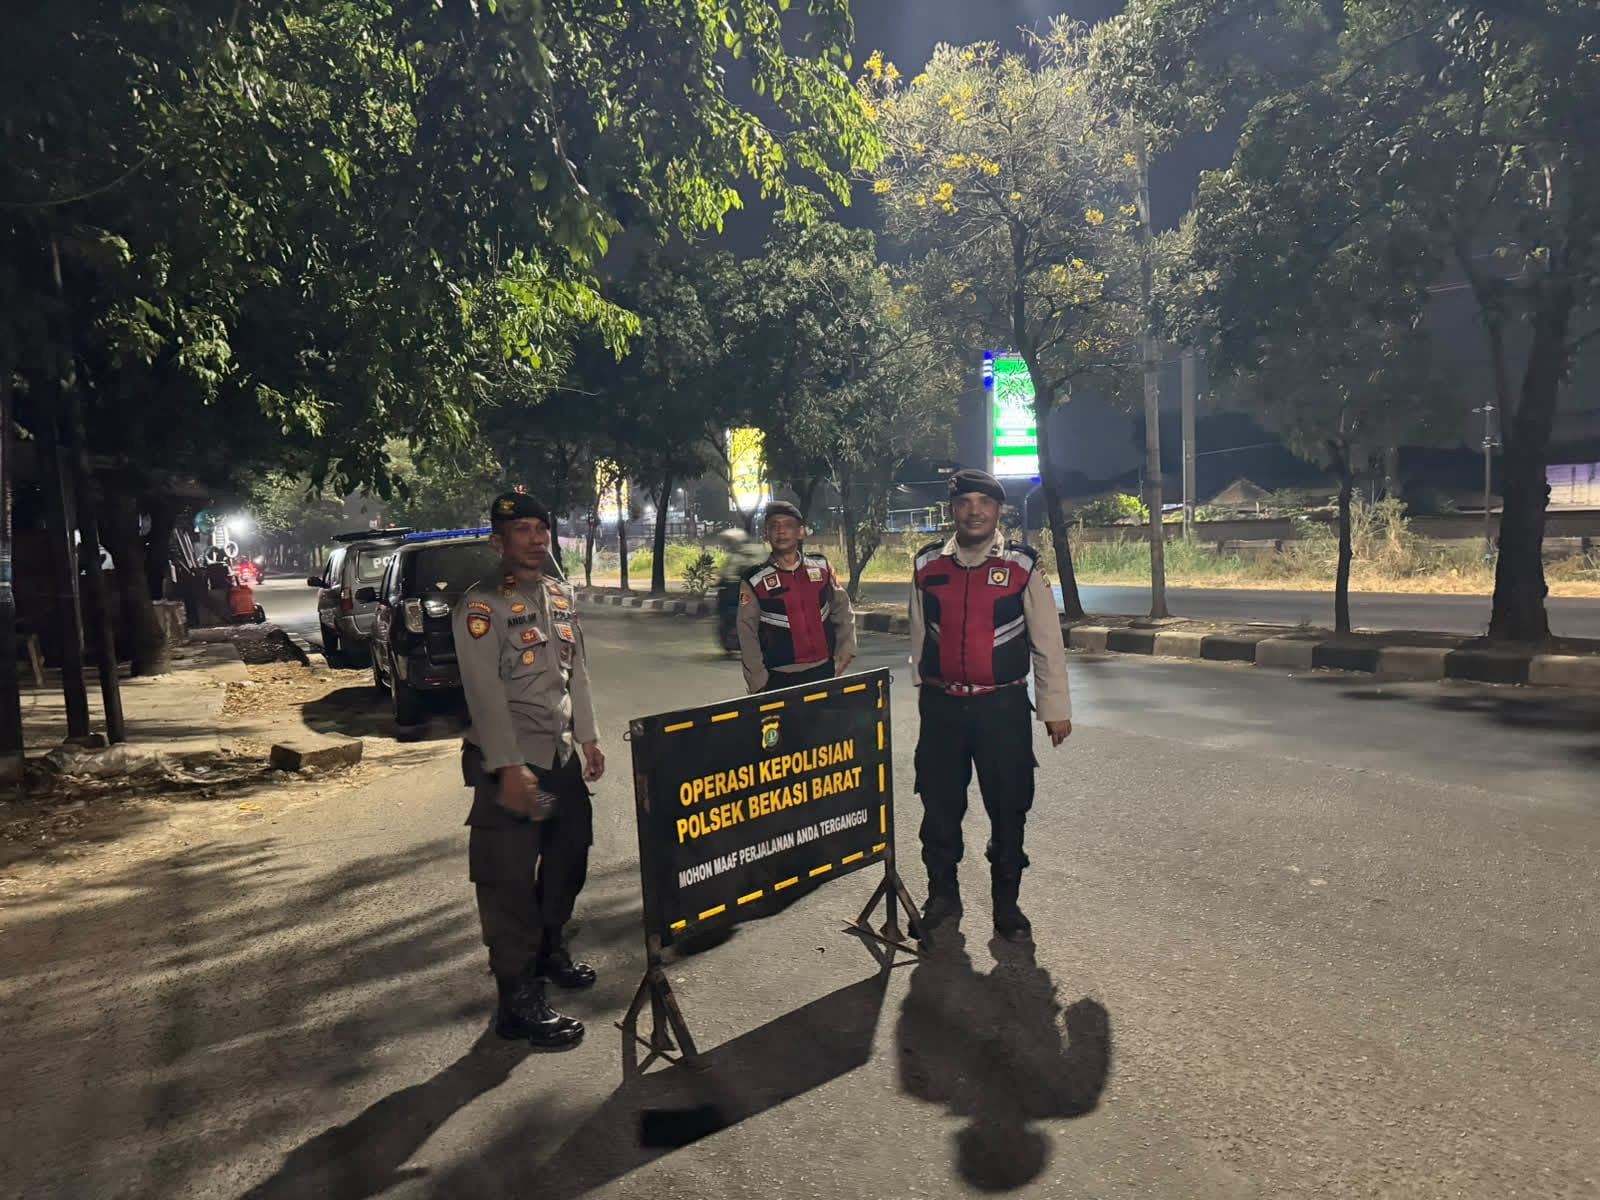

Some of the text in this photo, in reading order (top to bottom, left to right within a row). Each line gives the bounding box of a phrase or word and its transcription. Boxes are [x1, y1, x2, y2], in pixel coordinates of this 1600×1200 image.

[676, 766, 862, 844] POLSEK BEKASI BARAT
[680, 738, 854, 806] OPERASI KEPOLISIAN
[679, 808, 868, 888] MOHON MAAF PERJALANAN ANDA TERGANGGU
